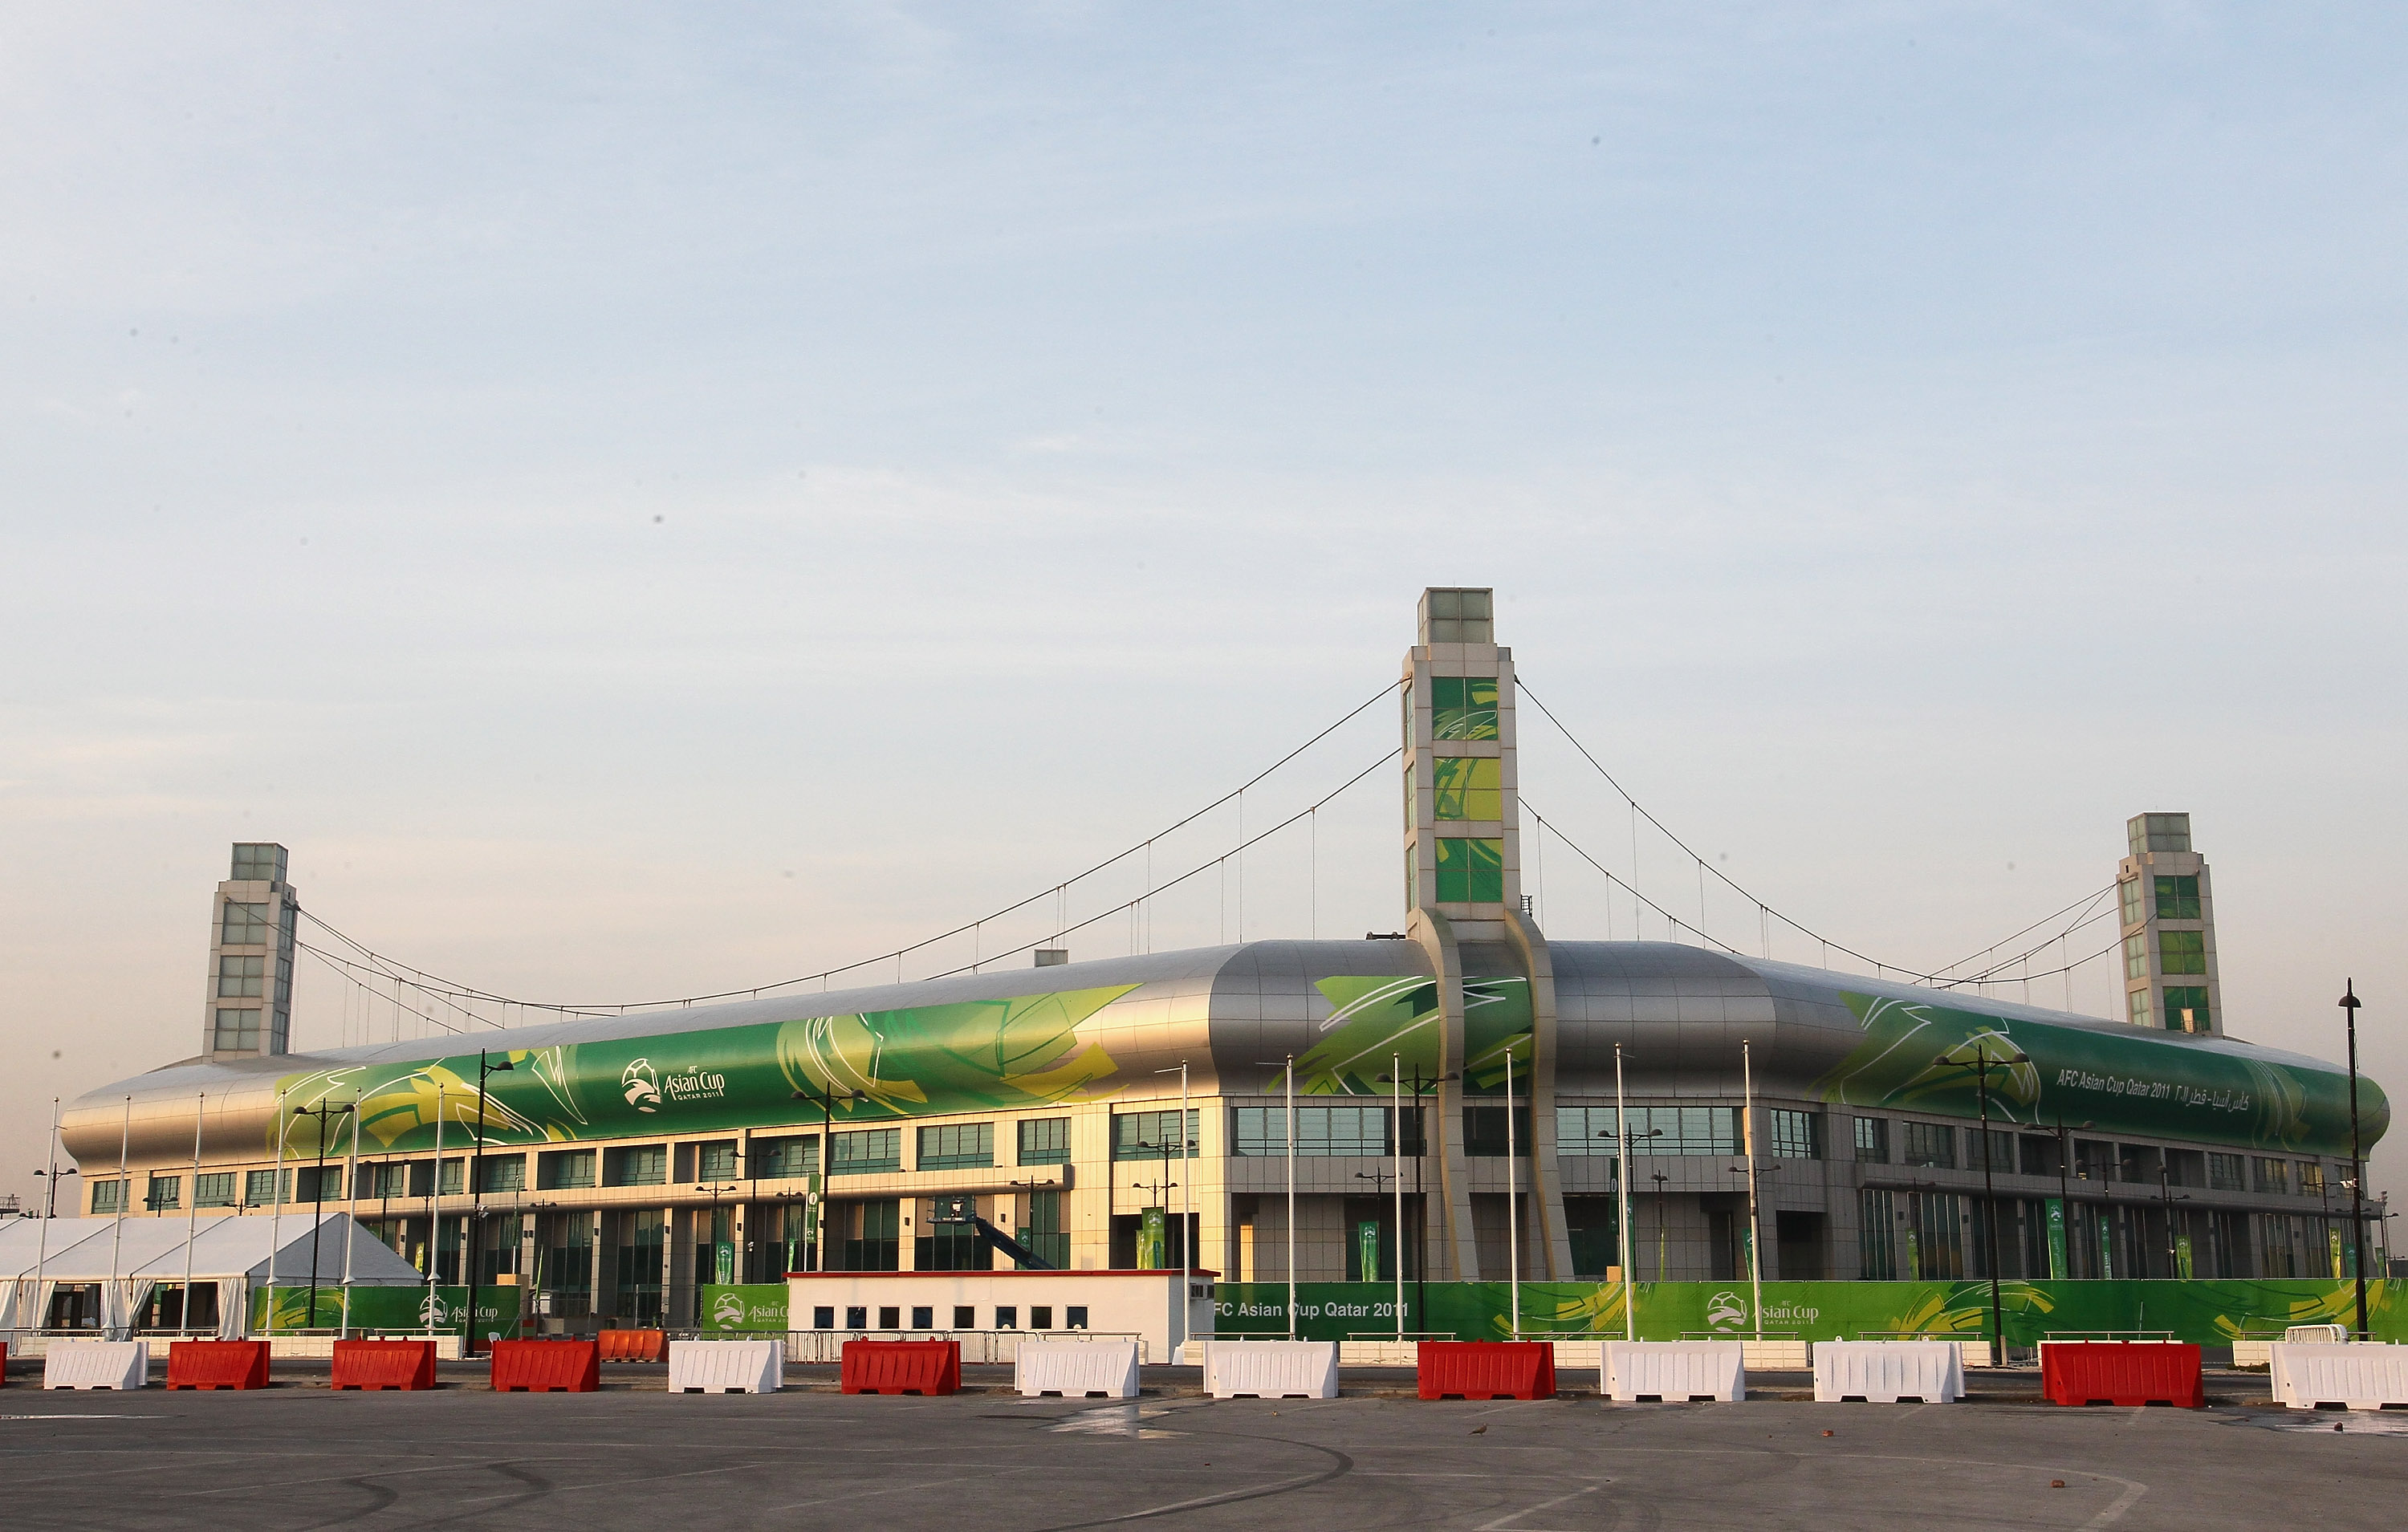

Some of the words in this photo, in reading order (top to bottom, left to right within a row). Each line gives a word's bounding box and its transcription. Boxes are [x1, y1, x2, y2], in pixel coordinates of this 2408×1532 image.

[687, 1065, 698, 1075] AFC
[665, 1074, 699, 1100] Asian
[700, 1071, 725, 1097] Cup
[2056, 1069, 2078, 1087] AFC
[2078, 1071, 2105, 1091] Asian
[2106, 1075, 2125, 1097] Cup
[2126, 1078, 2150, 1096] Qatar
[2150, 1082, 2170, 1100] 2011
[2186, 1088, 2207, 1107] قطر
[479, 1306, 498, 1323] Cup
[748, 1305, 778, 1323] Asian
[1237, 1302, 1283, 1317] Asian
[1324, 1302, 1369, 1317] Qatar
[1373, 1302, 1408, 1317] 2011
[1793, 1305, 1819, 1324] Cup
